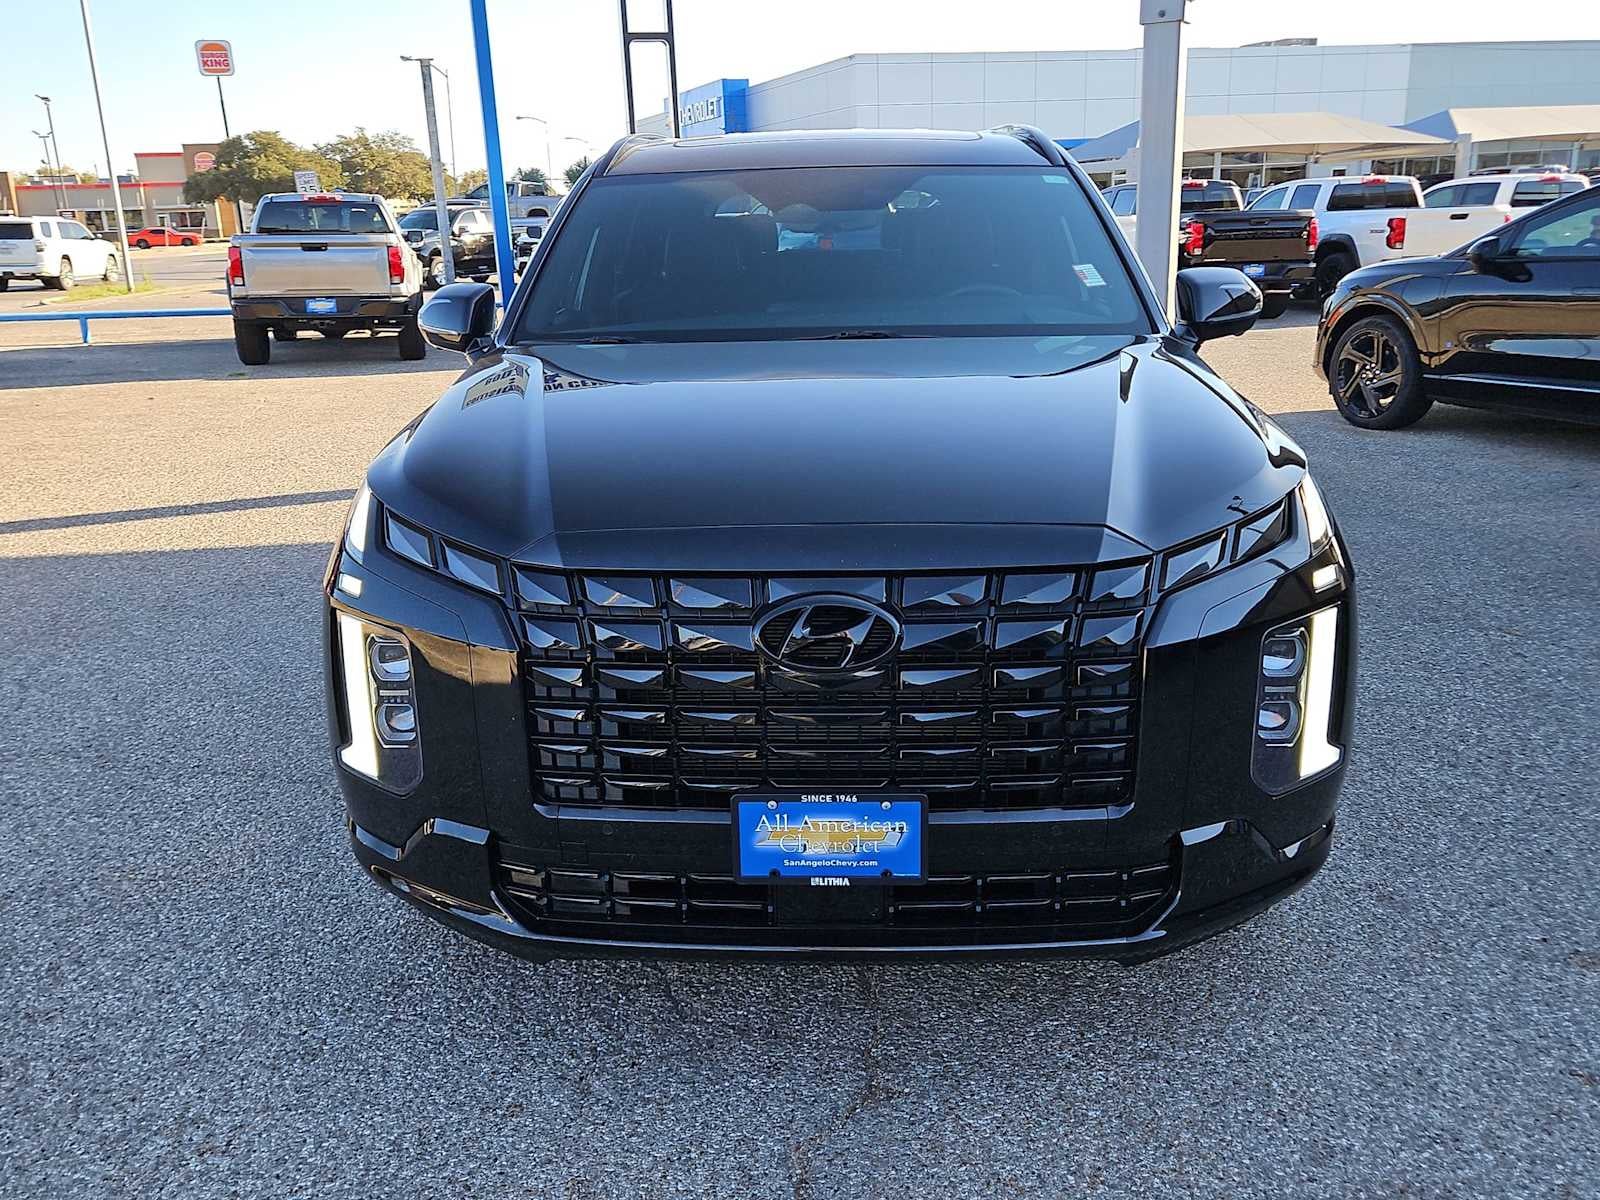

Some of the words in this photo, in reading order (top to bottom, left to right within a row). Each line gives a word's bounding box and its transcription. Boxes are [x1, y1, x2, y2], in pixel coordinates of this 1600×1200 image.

[202, 59, 230, 67] KING
[800, 794, 833, 803] SINCE
[835, 794, 858, 803] 1946
[754, 813, 789, 832] All
[798, 814, 909, 833] American
[779, 833, 881, 853] Chevrolet
[783, 859, 878, 868] SanAngeloChevy.com
[819, 877, 850, 886] LITHIA
